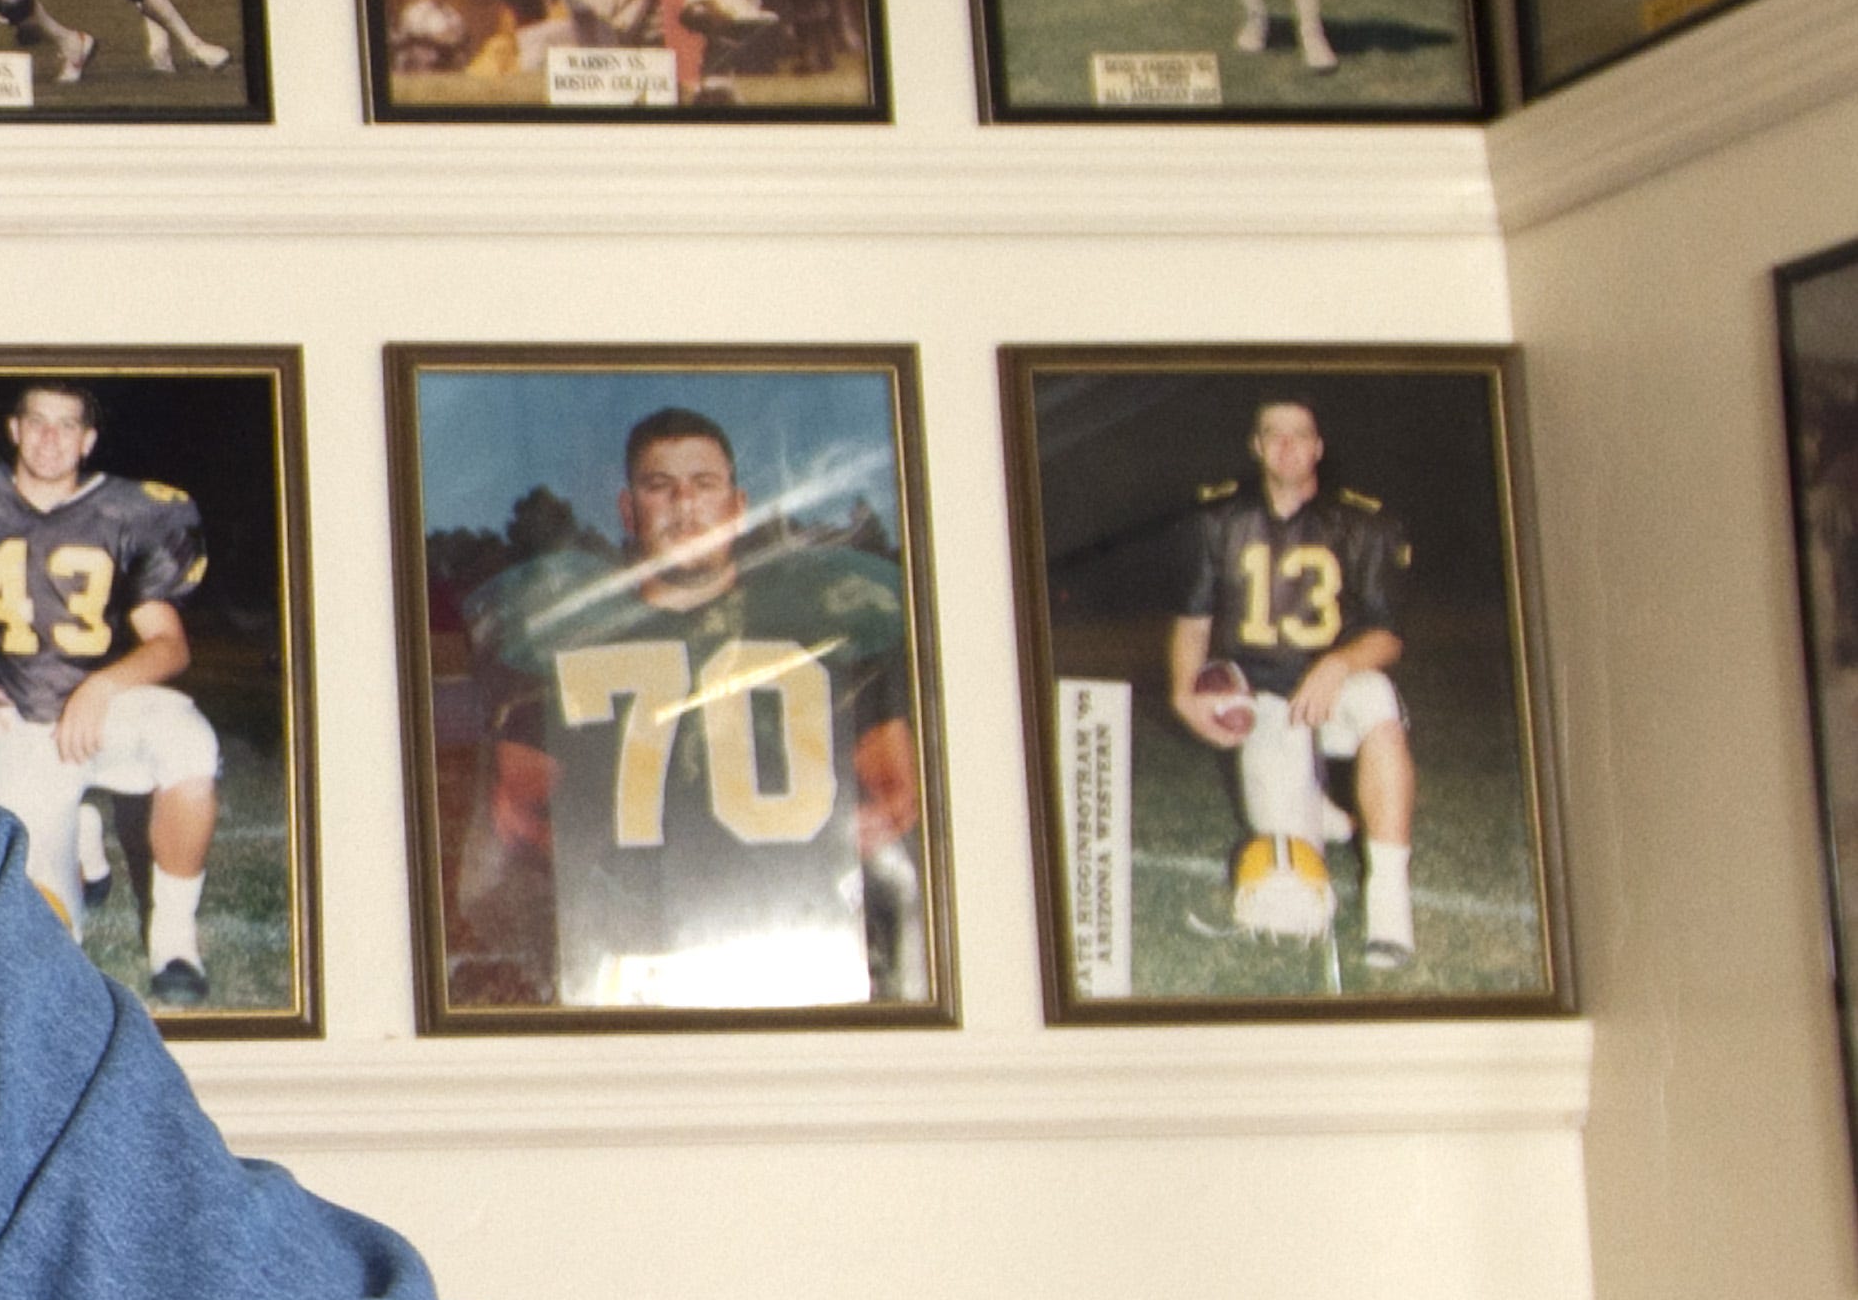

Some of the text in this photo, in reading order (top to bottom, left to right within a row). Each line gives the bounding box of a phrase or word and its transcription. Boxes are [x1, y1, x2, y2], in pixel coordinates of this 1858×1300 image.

[554, 73, 606, 91] BOSTON
[567, 54, 622, 71] WARREN
[1238, 542, 1342, 649] 13
[555, 639, 837, 848] 70
[1074, 729, 1094, 928] HIGGINBOTHAM
[1094, 722, 1113, 966] ARIZONA WESTERN
